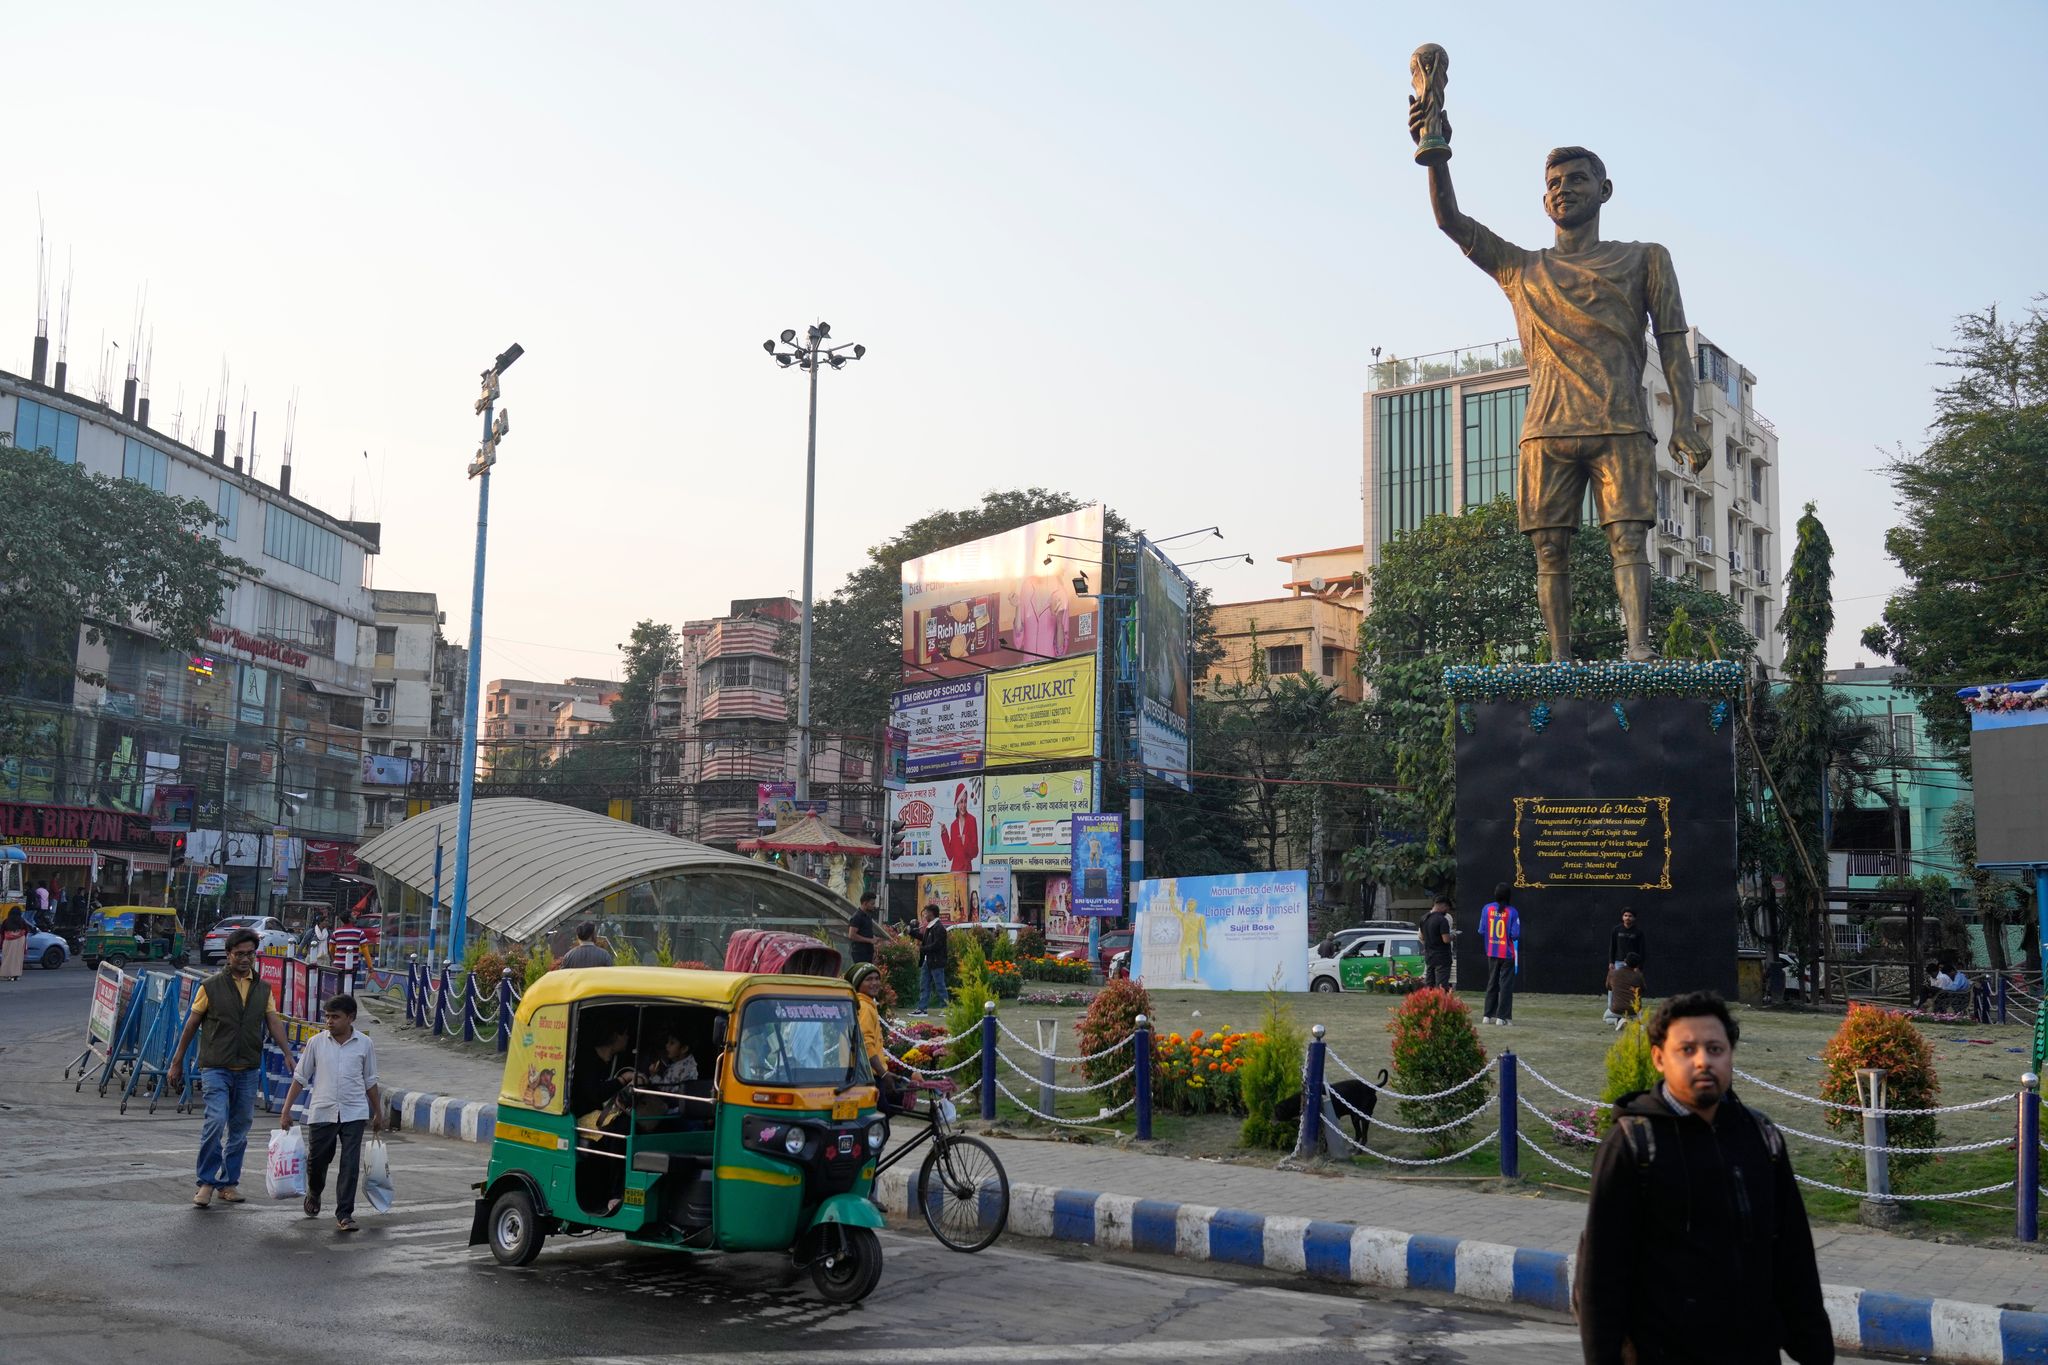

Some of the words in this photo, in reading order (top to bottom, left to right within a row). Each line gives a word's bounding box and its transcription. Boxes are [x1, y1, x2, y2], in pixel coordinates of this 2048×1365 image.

[937, 622, 953, 639] Rich
[954, 618, 976, 635] Marie
[902, 694, 912, 703] IEM
[912, 689, 933, 702] GROUP
[933, 688, 941, 698] OF
[941, 682, 971, 696] SCHOOLS
[1002, 678, 1076, 704] KARUKRIT
[942, 703, 951, 711] IEM
[965, 700, 974, 708] IEM
[938, 713, 954, 722] PUBLIC
[961, 709, 977, 718] PUBLIC
[916, 717, 932, 725] PUBLIC
[960, 719, 979, 729] SCHOOL
[915, 726, 933, 736] SCHOOL
[937, 723, 955, 732] SCHOOL
[1532, 804, 1598, 814] Monumento
[1599, 802, 1613, 814] de
[1614, 803, 1648, 814] Messi
[43, 809, 123, 843] BIRYANI
[1534, 818, 1574, 827] Inaugurated
[1574, 818, 1581, 827] by
[1623, 818, 1648, 827] himself
[1581, 829, 1589, 838] of
[1605, 829, 1620, 838] Sujit
[16, 837, 60, 846] RESTAURANT
[60, 839, 75, 847] PVT.
[76, 840, 88, 848] LTD
[1561, 840, 1598, 848] Government
[1599, 840, 1607, 848] of
[1625, 840, 1650, 848] Bengal
[1599, 850, 1626, 859] Sporting
[1210, 885, 1259, 897] Monumento
[1261, 884, 1272, 895] de
[1274, 882, 1297, 893] Messi
[1205, 905, 1234, 918] Lionel
[1237, 904, 1263, 916] Messi
[1265, 902, 1301, 914] himself
[1230, 923, 1250, 933] Sujit
[1252, 923, 1275, 932] Bose
[1490, 918, 1505, 939] 10
[273, 1158, 300, 1178] SALE
